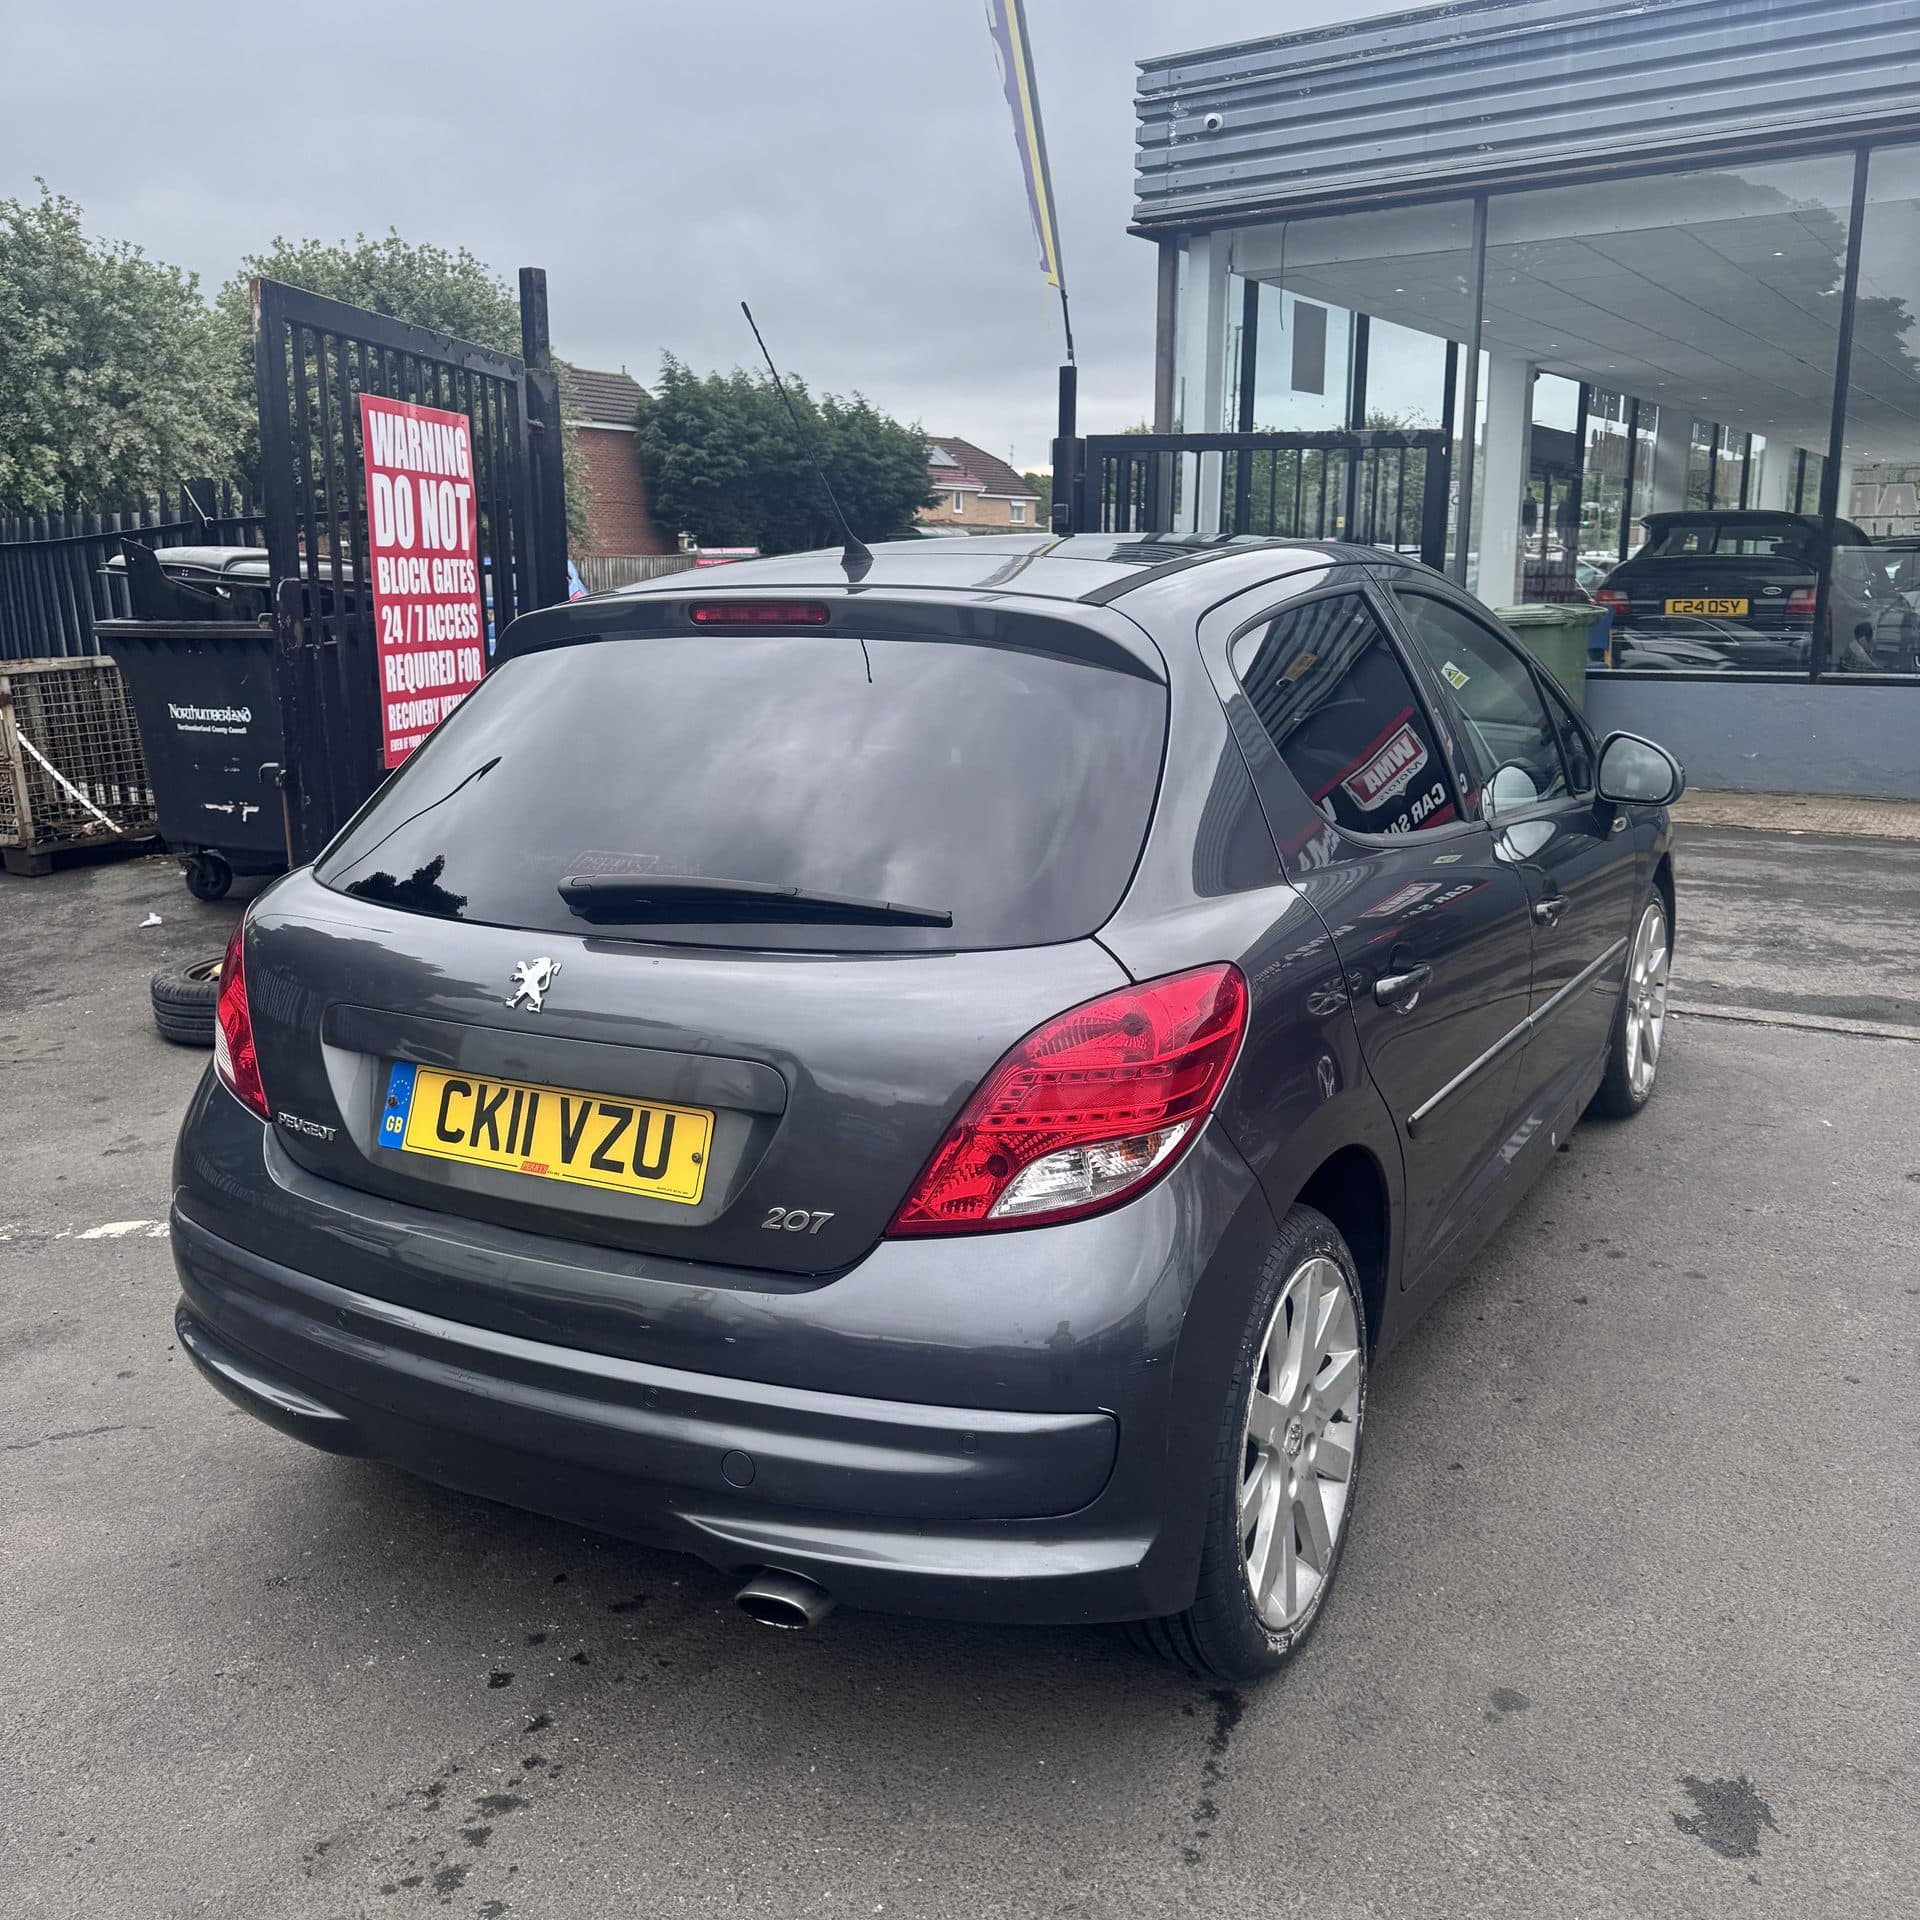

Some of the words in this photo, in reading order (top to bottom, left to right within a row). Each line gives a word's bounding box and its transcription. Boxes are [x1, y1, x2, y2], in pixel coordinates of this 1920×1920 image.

[368, 410, 469, 479] WARNING
[372, 472, 415, 549] DO
[419, 479, 471, 551] NOT
[377, 556, 431, 595] BLOCK
[432, 558, 476, 594] GATES
[426, 603, 478, 641] ACCESS
[1672, 601, 1704, 613] C24
[385, 650, 455, 694] REQUIRED
[457, 647, 481, 683] FOR
[388, 697, 439, 732] RECOVERY
[279, 1111, 338, 1141] PEUGEOT
[386, 1115, 404, 1133] GB
[436, 1080, 540, 1157] CK11
[560, 1097, 677, 1180] VZU
[761, 1207, 835, 1234] 207
